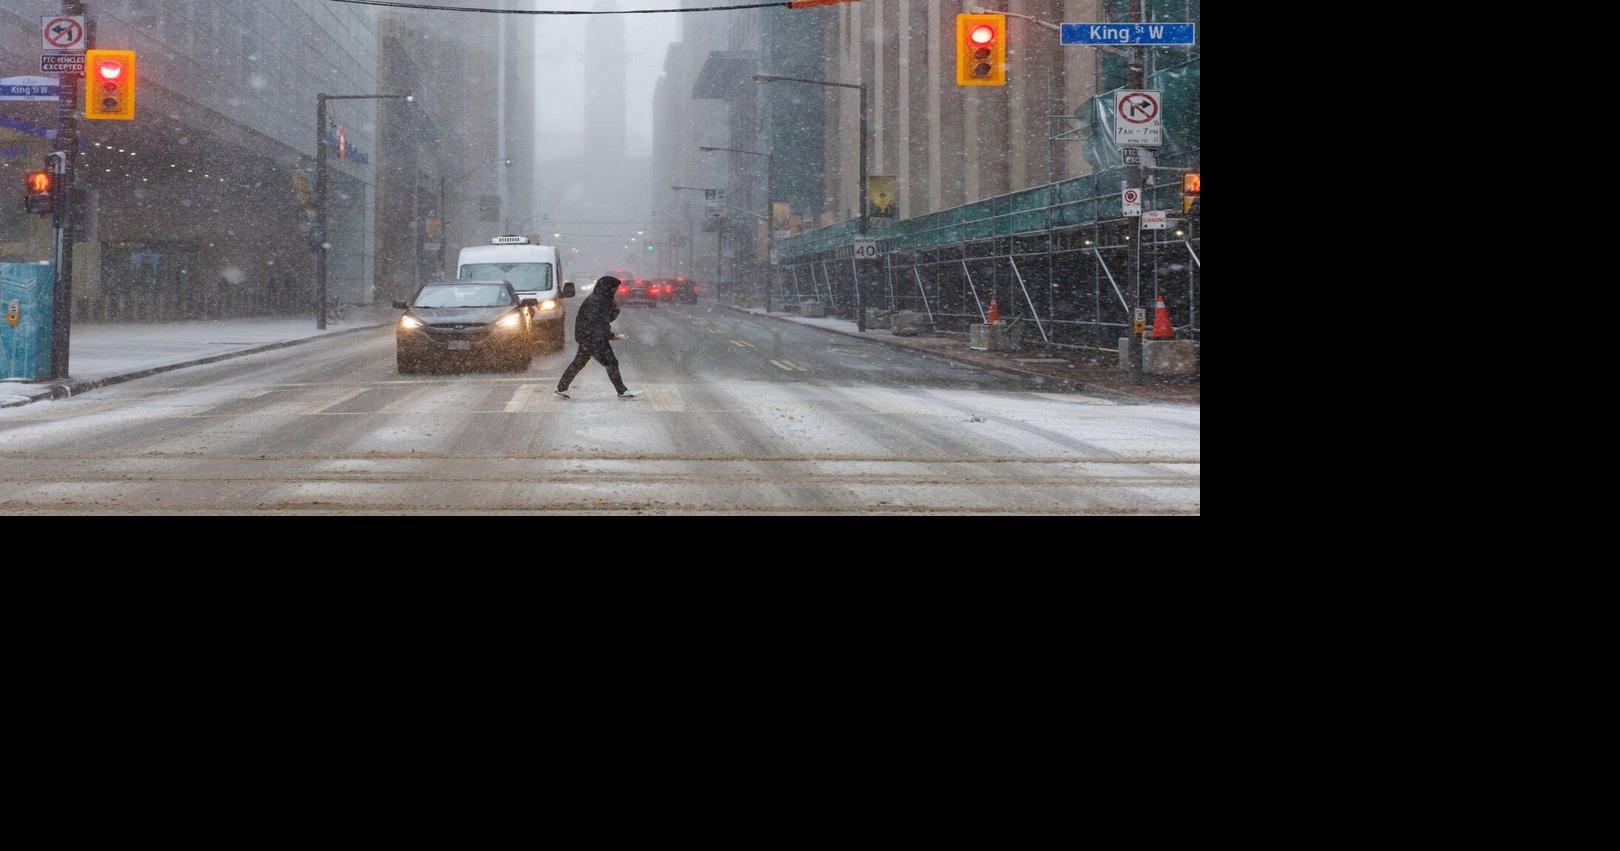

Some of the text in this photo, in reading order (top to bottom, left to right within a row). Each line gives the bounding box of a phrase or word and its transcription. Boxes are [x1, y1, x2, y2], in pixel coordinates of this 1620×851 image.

[1090, 25, 1164, 43] King St W
[43, 63, 83, 71] EXCEPTED
[11, 86, 31, 95] King
[40, 86, 48, 94] W
[856, 245, 875, 257] 40
